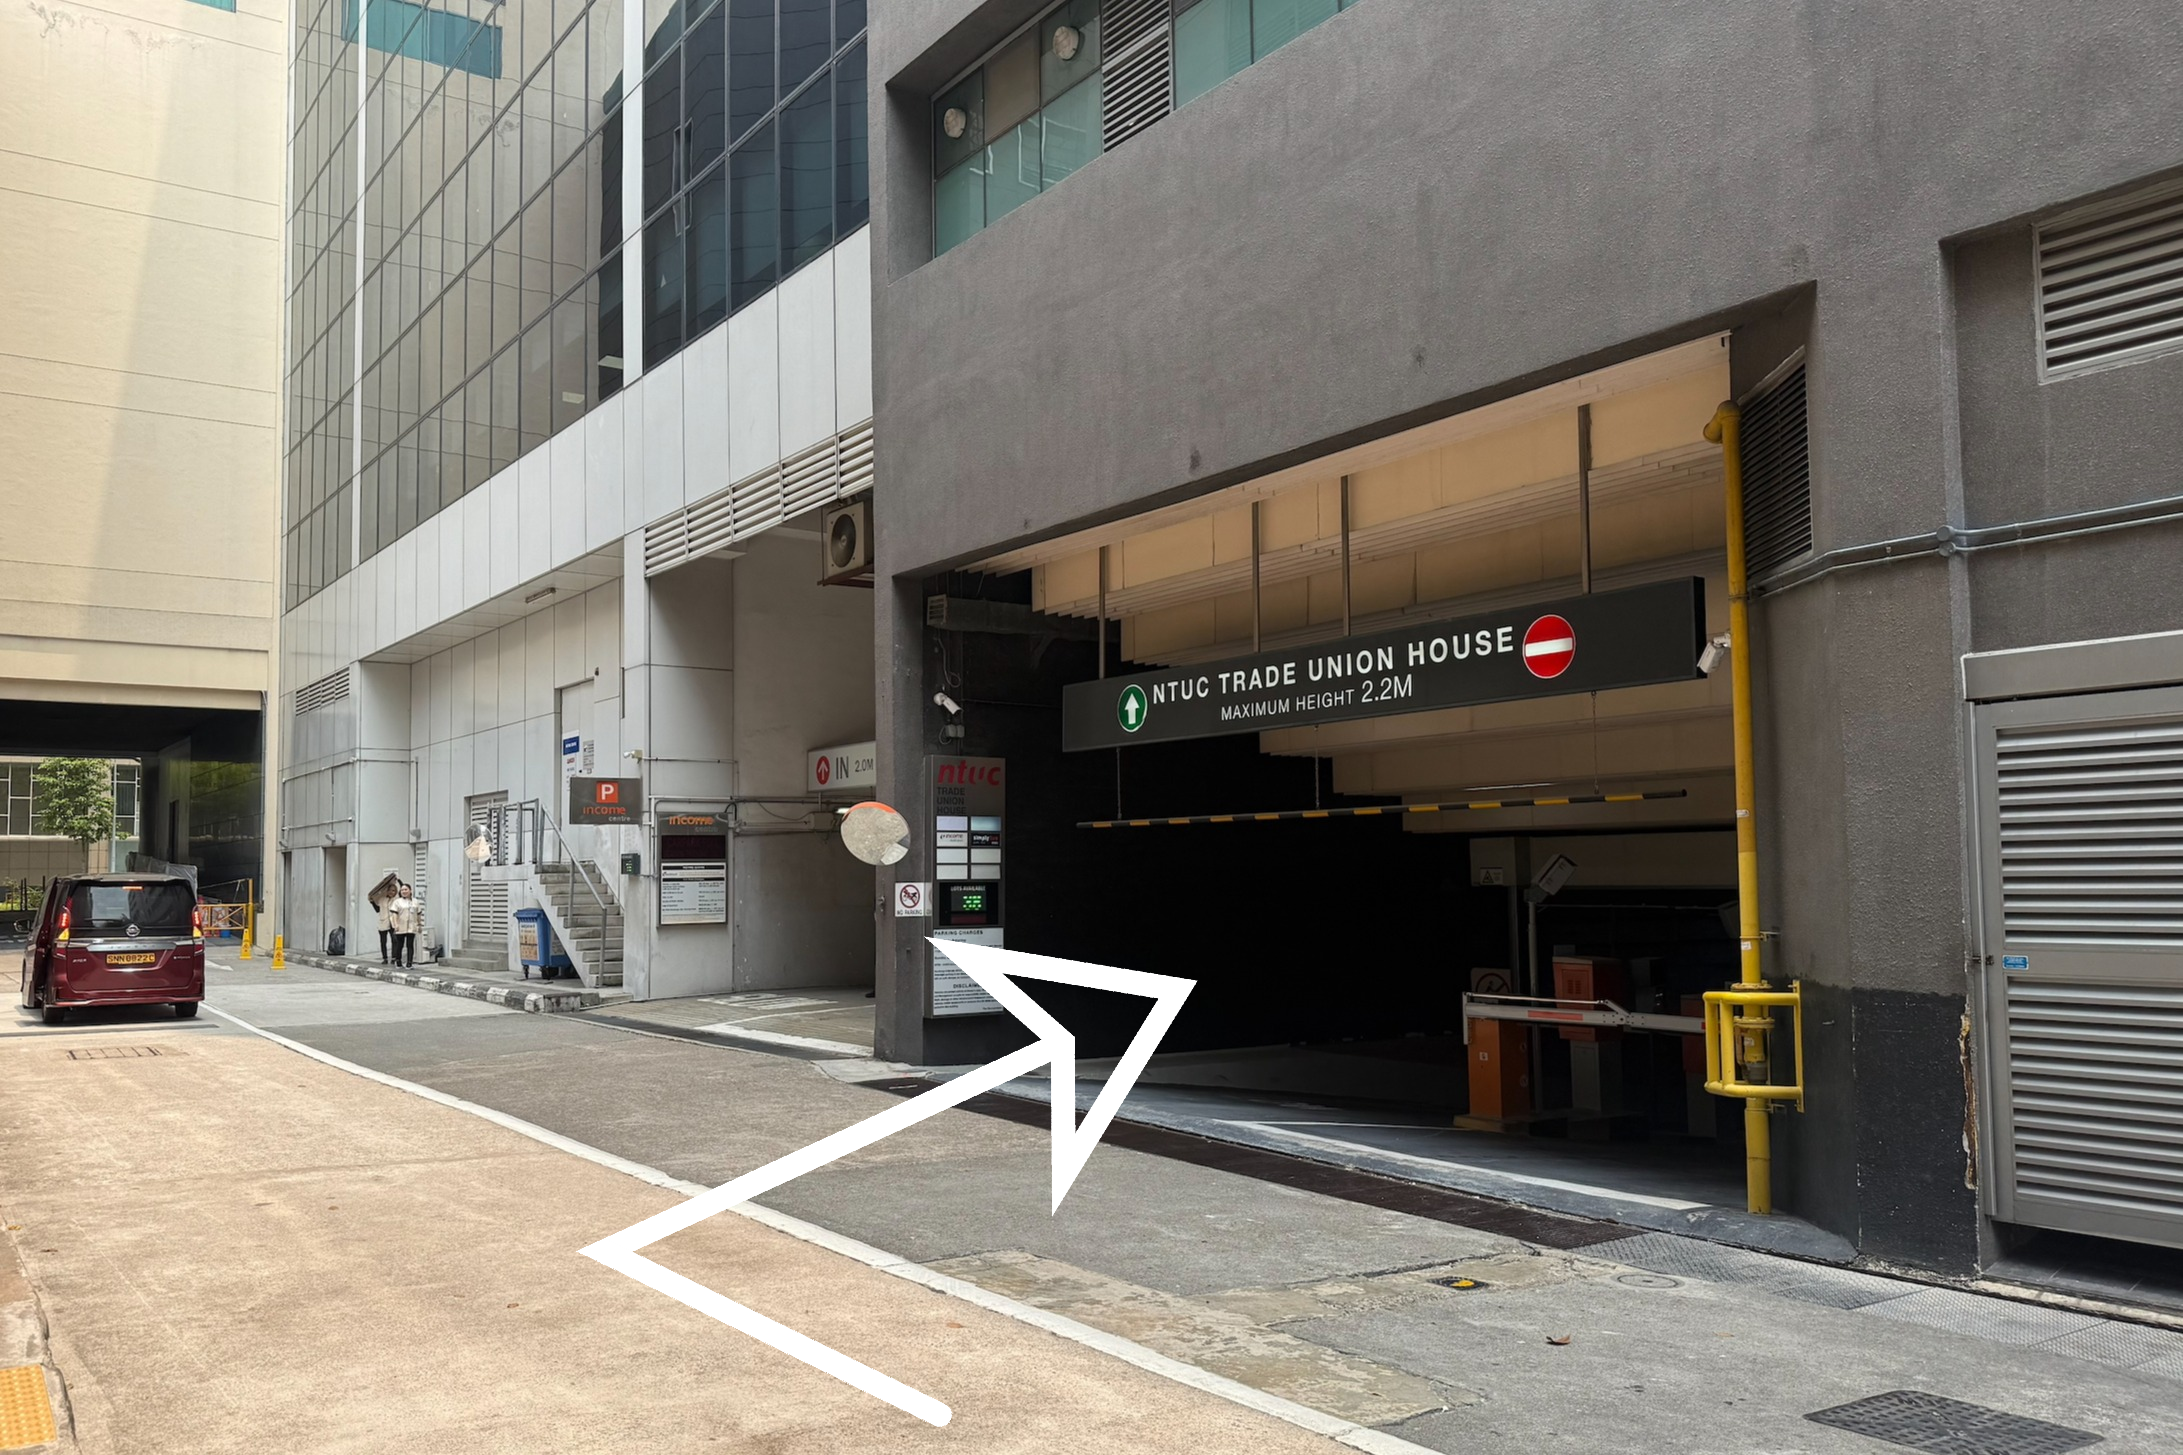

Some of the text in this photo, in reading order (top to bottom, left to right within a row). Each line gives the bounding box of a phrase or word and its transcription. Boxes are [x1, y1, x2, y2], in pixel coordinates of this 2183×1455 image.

[1153, 626, 1514, 704] NTUC TRADE UNION HOUSE
[1220, 674, 1413, 721] MAXIMUM HEIGHT 2.2M
[835, 756, 874, 780] IN 2.0M
[601, 784, 615, 801] P
[936, 787, 966, 796] TRADE
[936, 797, 965, 805] UNION
[582, 805, 626, 815] income
[936, 806, 967, 814] HOUSE
[669, 815, 714, 825] income
